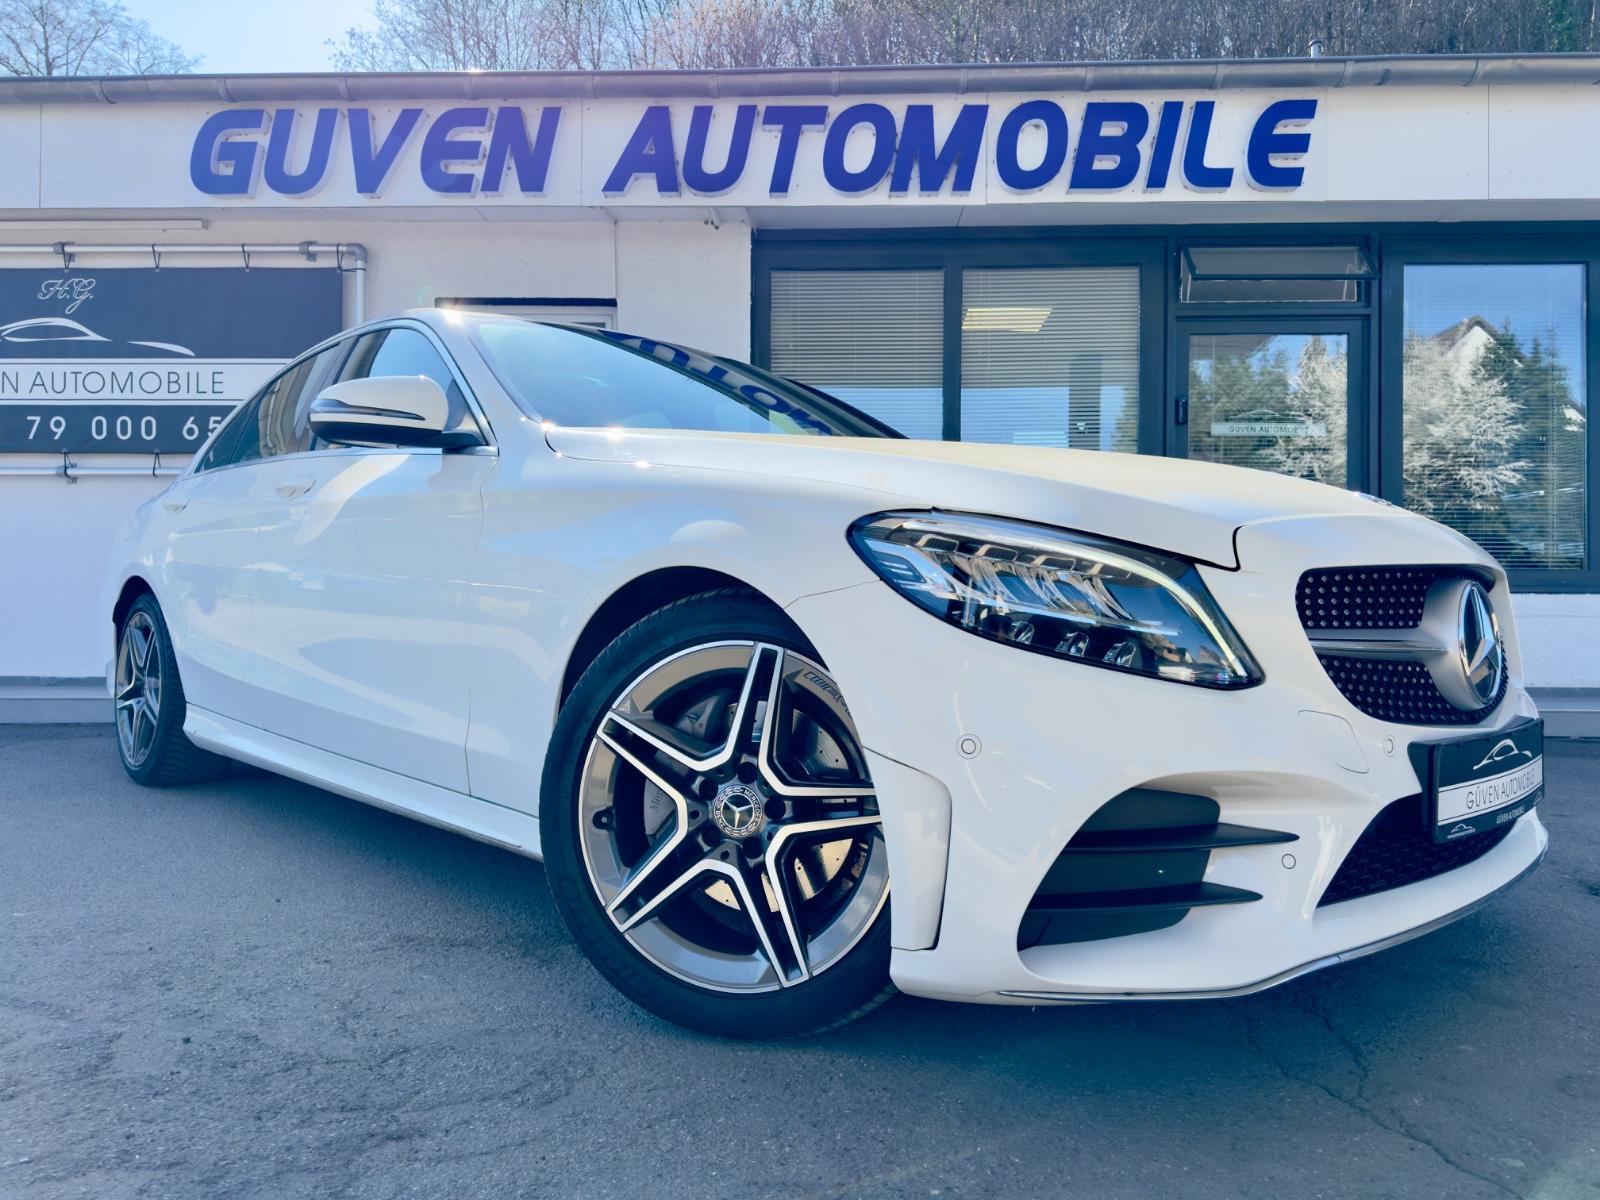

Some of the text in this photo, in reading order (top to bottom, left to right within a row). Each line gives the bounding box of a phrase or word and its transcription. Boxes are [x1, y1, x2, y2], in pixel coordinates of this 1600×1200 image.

[190, 99, 1318, 196] GUVEN AUTOMOBILE
[29, 371, 224, 394] AUTOMOBILE
[26, 415, 66, 440] 79
[91, 415, 157, 440] 000
[1466, 784, 1500, 810] GÜVEN
